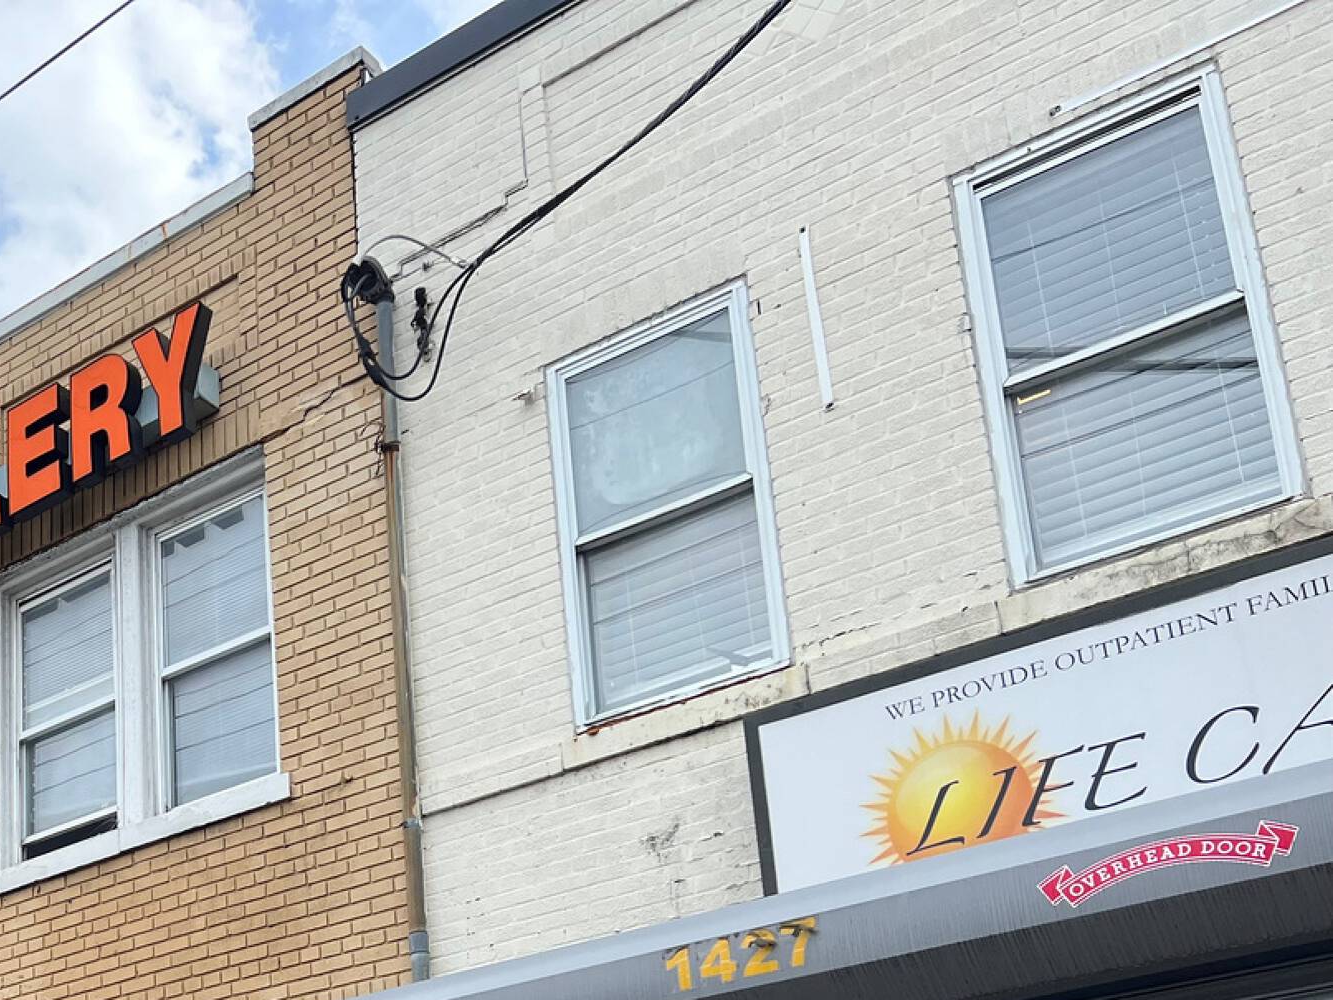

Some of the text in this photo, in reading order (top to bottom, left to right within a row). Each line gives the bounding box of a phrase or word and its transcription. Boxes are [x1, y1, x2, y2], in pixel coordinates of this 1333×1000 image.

[885, 695, 925, 720] WE
[931, 659, 1048, 708] PROVIDE
[1055, 602, 1238, 672] OUTPATIENT
[906, 731, 1148, 856] LIFE
[1069, 840, 1267, 897] OVERHEAD DOOR
[666, 915, 817, 992] 1427
